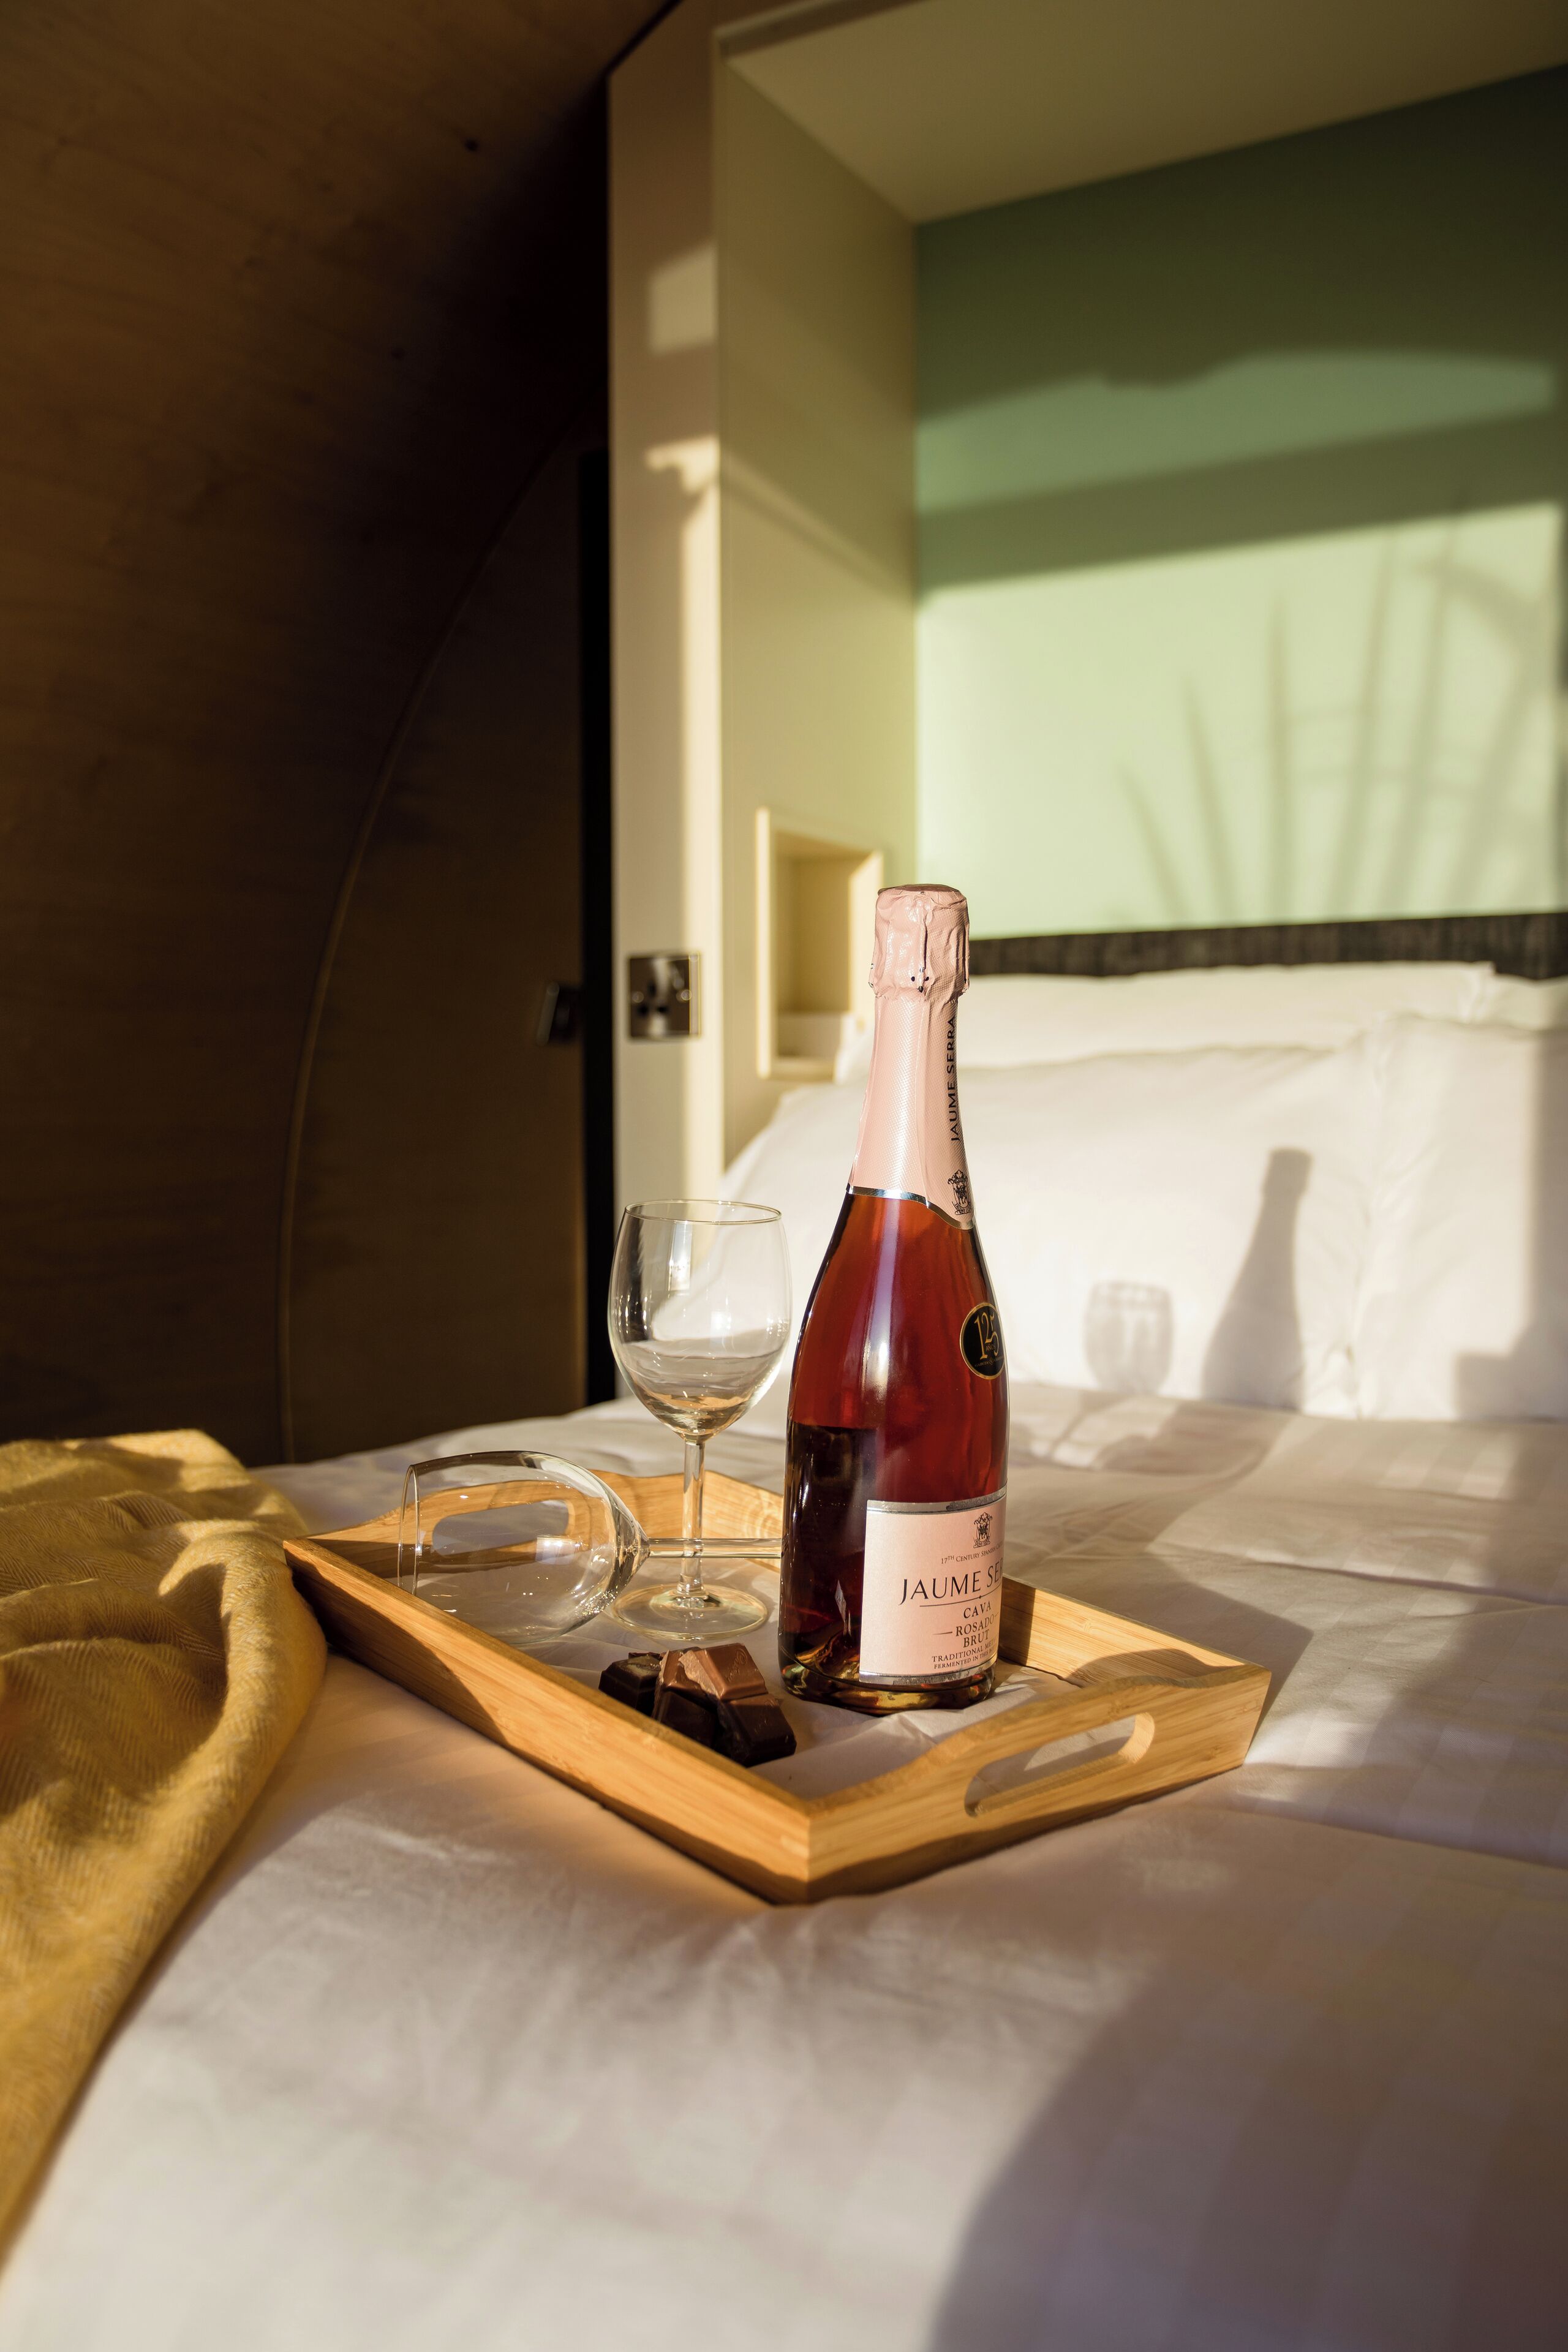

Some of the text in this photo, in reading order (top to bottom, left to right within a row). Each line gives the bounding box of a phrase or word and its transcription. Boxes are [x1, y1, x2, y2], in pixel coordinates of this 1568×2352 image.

[946, 1015, 961, 1142] JAUME SERRA
[941, 1555, 954, 1564] 17TH
[899, 1558, 1004, 1606] JAUME SER
[963, 1600, 991, 1619] CAVA
[956, 1614, 994, 1637] ROSADO
[963, 1629, 990, 1648] BRUT
[931, 1646, 983, 1662] TRADITIONAL
[934, 1658, 971, 1669] FERMENTED
